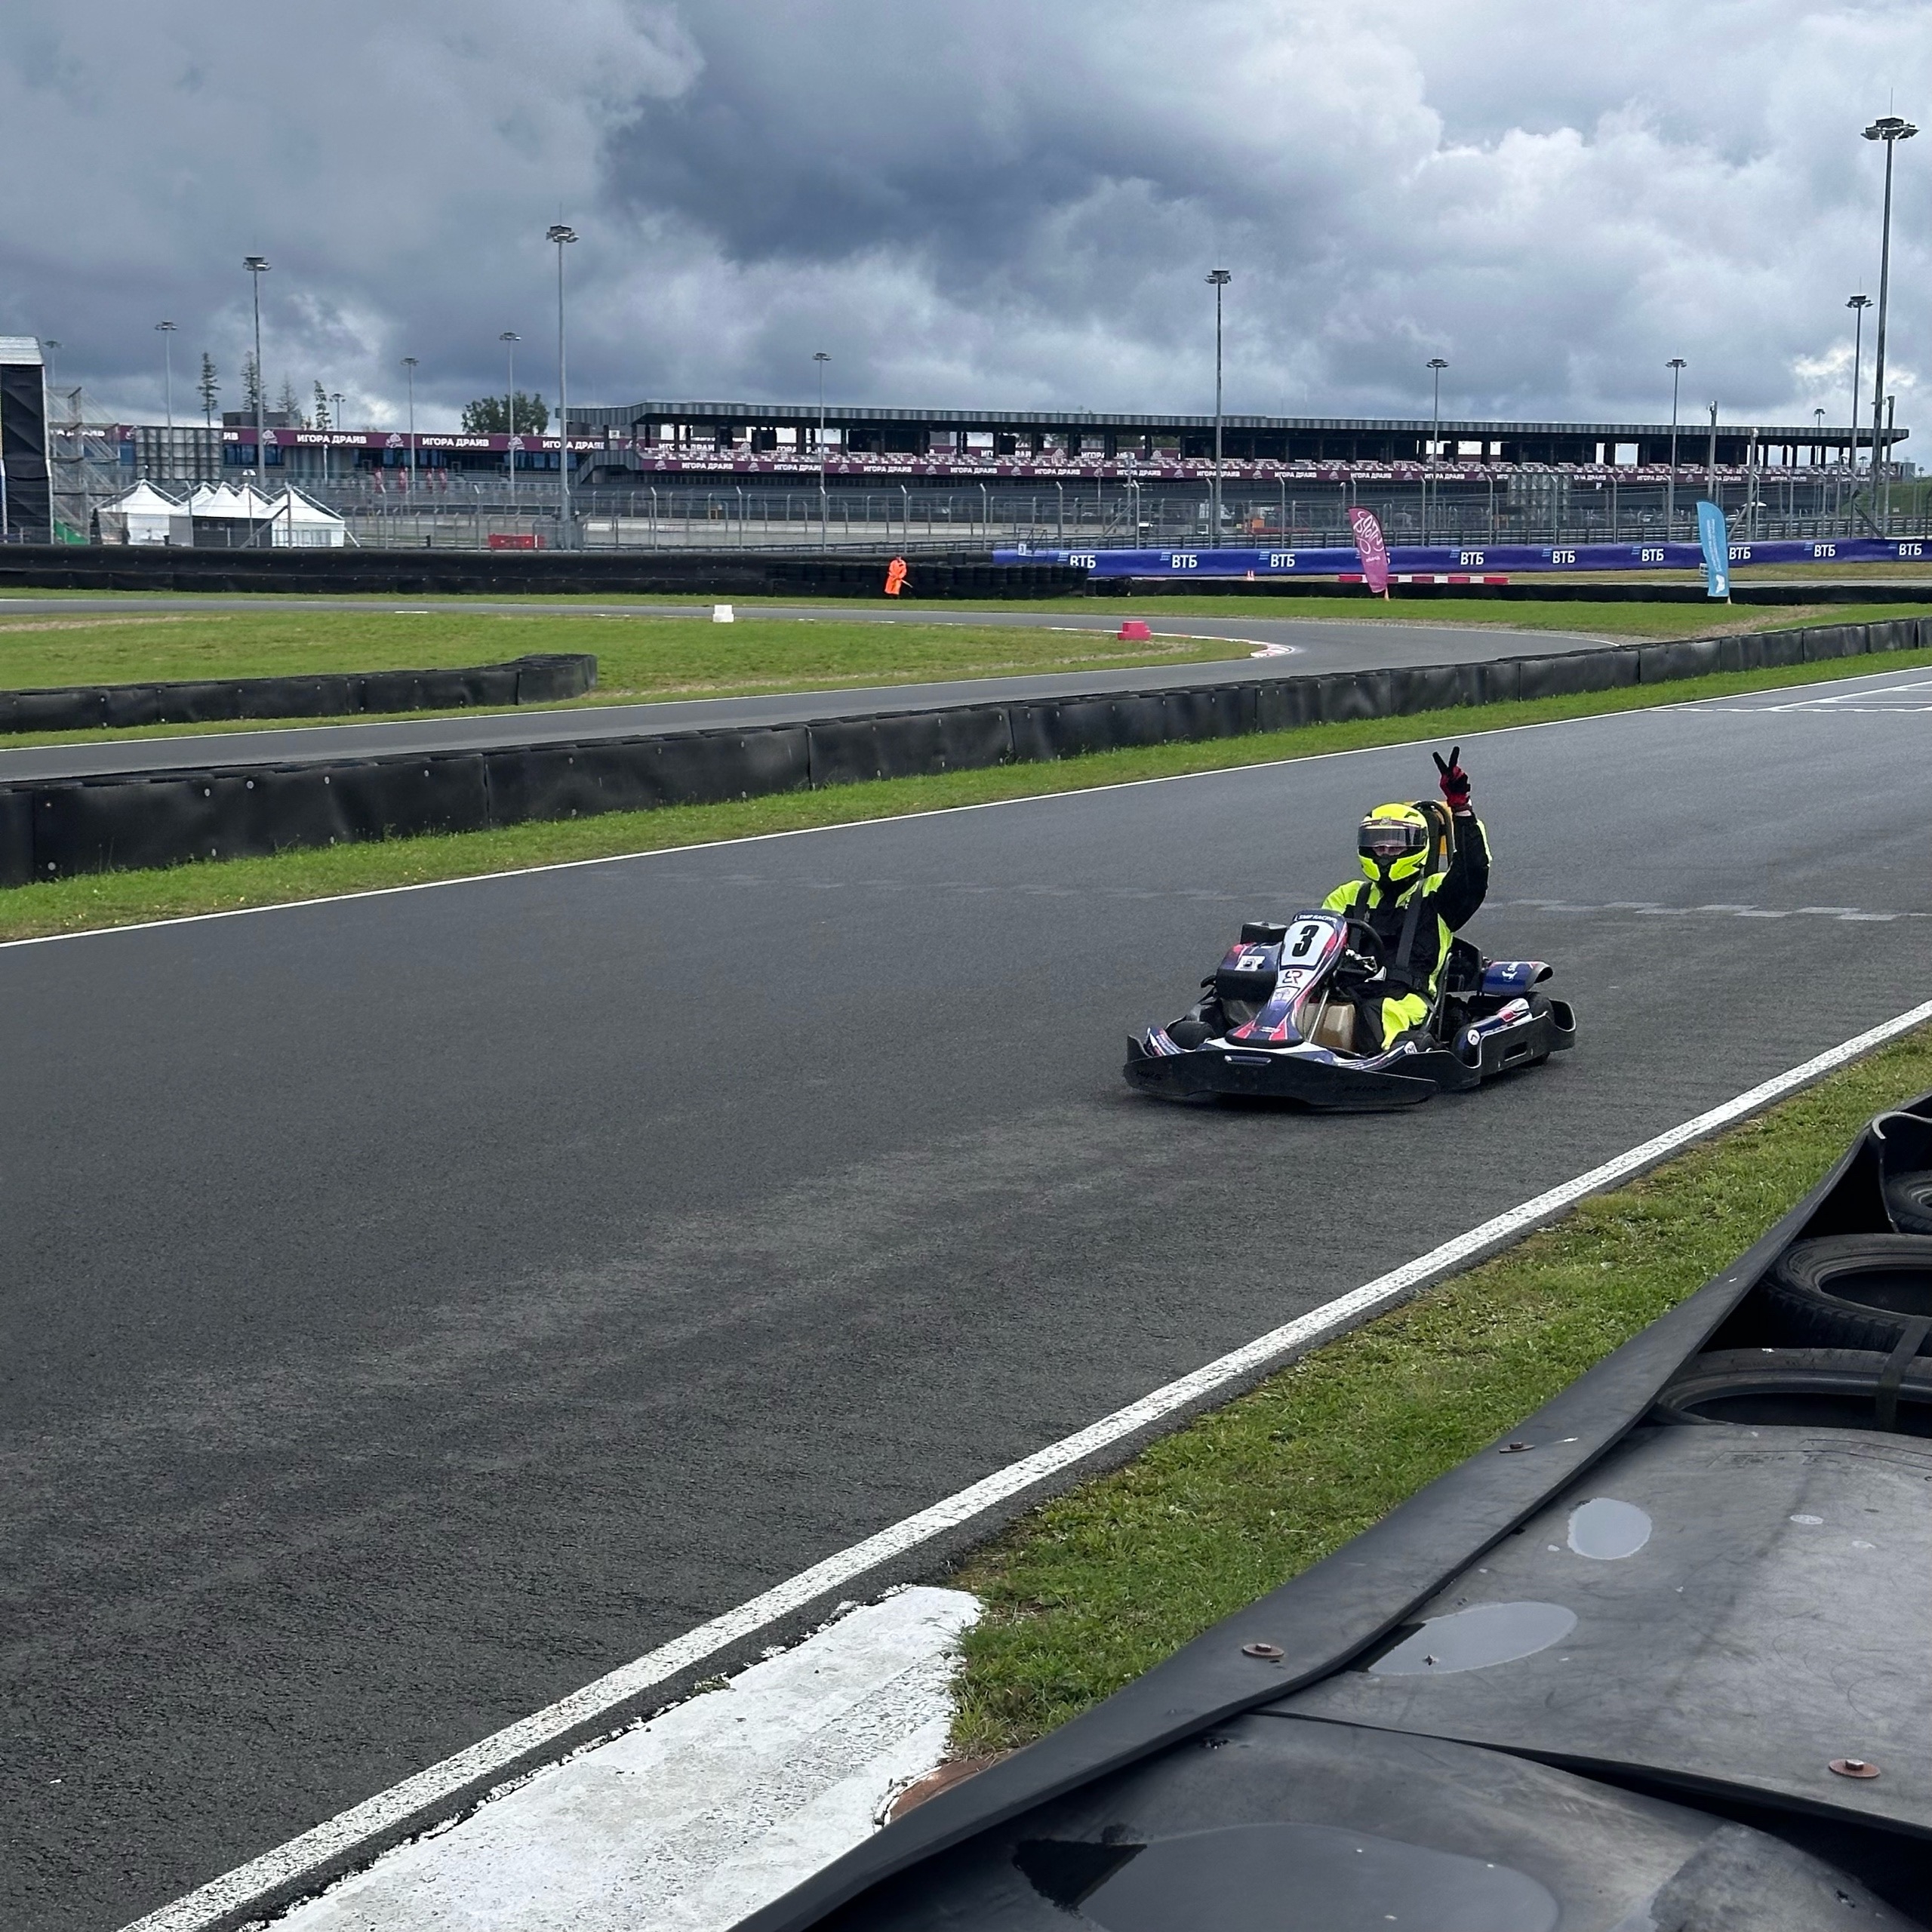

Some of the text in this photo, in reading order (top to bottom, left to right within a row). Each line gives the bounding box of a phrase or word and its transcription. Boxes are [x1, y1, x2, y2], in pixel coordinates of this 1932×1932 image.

[297, 435, 331, 444] ИГОРА
[422, 438, 490, 448] ИГОРА ДРАЙВ
[542, 440, 574, 448] ИГОА
[1641, 548, 1665, 561] ВТБ
[1729, 546, 1752, 560] ВТБ
[1814, 544, 1836, 557] ВТБ
[1899, 543, 1922, 556] ВТБ
[1070, 554, 1097, 568] ВТБ
[1171, 554, 1198, 568] ВТБ
[1270, 553, 1296, 568] ВТБ
[1460, 552, 1484, 565] ВТБ
[1552, 550, 1576, 564] ВТБ
[1291, 924, 1319, 957] 3
